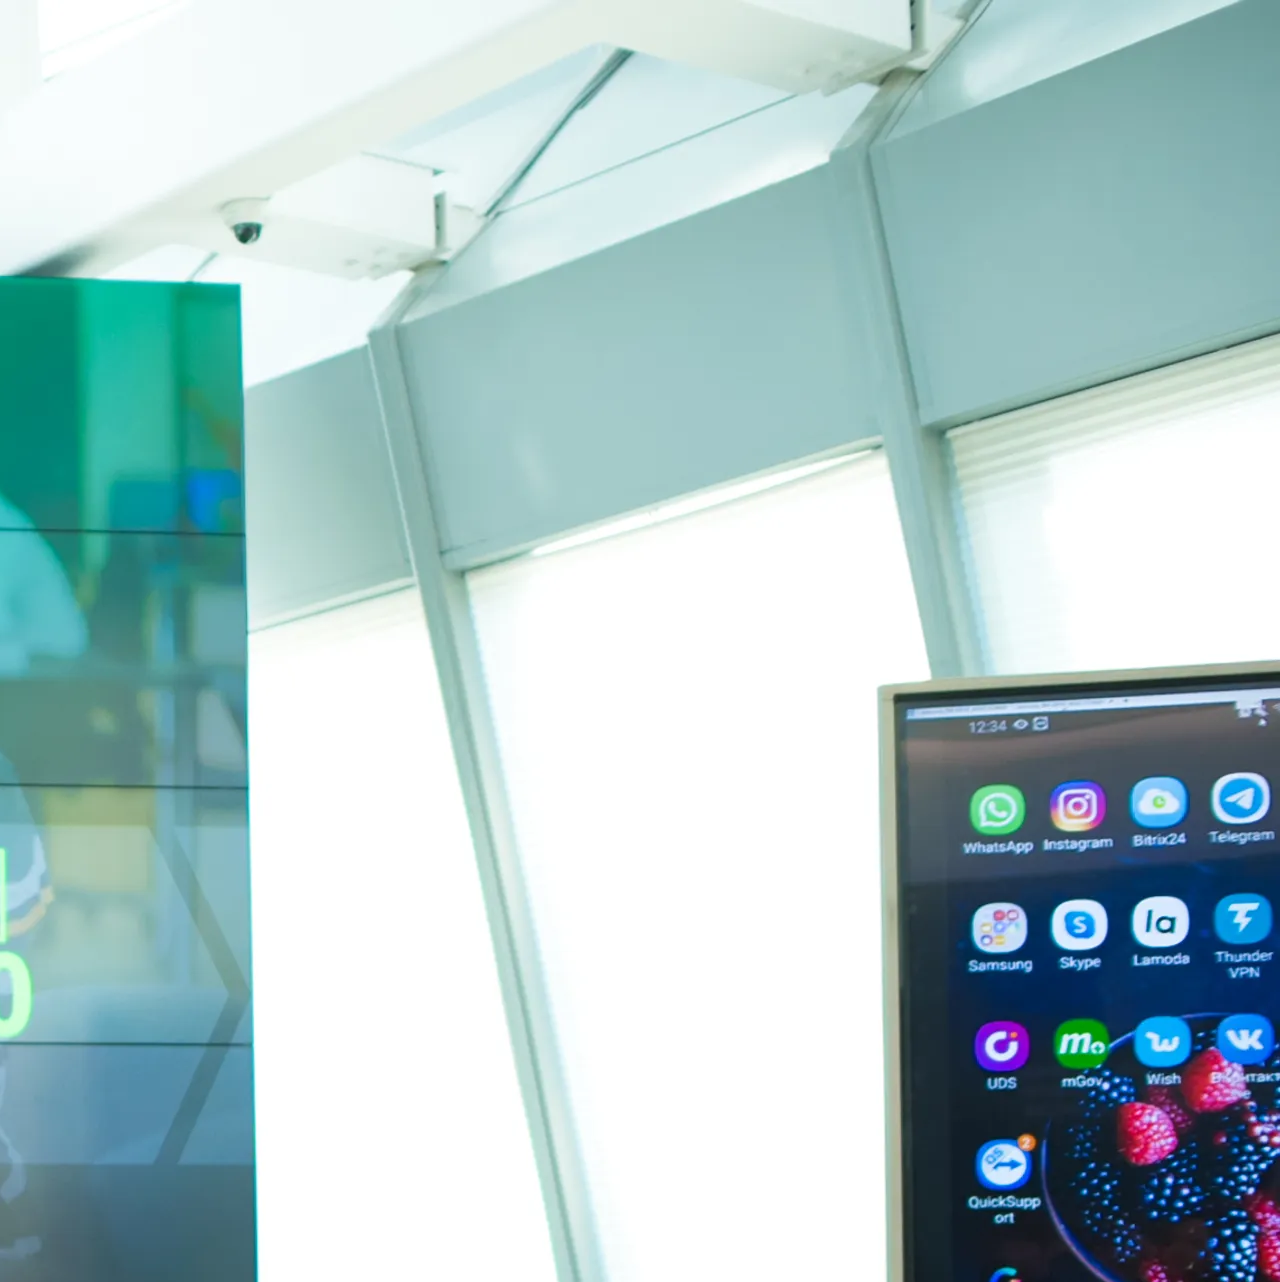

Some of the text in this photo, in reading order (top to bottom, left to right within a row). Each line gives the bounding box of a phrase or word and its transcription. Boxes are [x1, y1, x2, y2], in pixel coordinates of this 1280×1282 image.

[968, 720, 1008, 734] 12:34
[1132, 832, 1188, 847] Bitrix24
[1209, 829, 1276, 845] Telegram
[962, 840, 1035, 855] WhatsApp
[1043, 837, 1114, 854] Instagram
[1059, 956, 1102, 971] Skype
[1132, 952, 1191, 967] Lamoda
[1215, 949, 1274, 963] Thunder
[968, 958, 1034, 974] Samsung
[1228, 966, 1261, 979] VPN
[986, 1076, 1018, 1090] UDS
[1061, 1075, 1104, 1089] mGov
[1146, 1071, 1182, 1086] Wish
[968, 1195, 1042, 1210] QuickSupp
[994, 1212, 1016, 1224] ort
